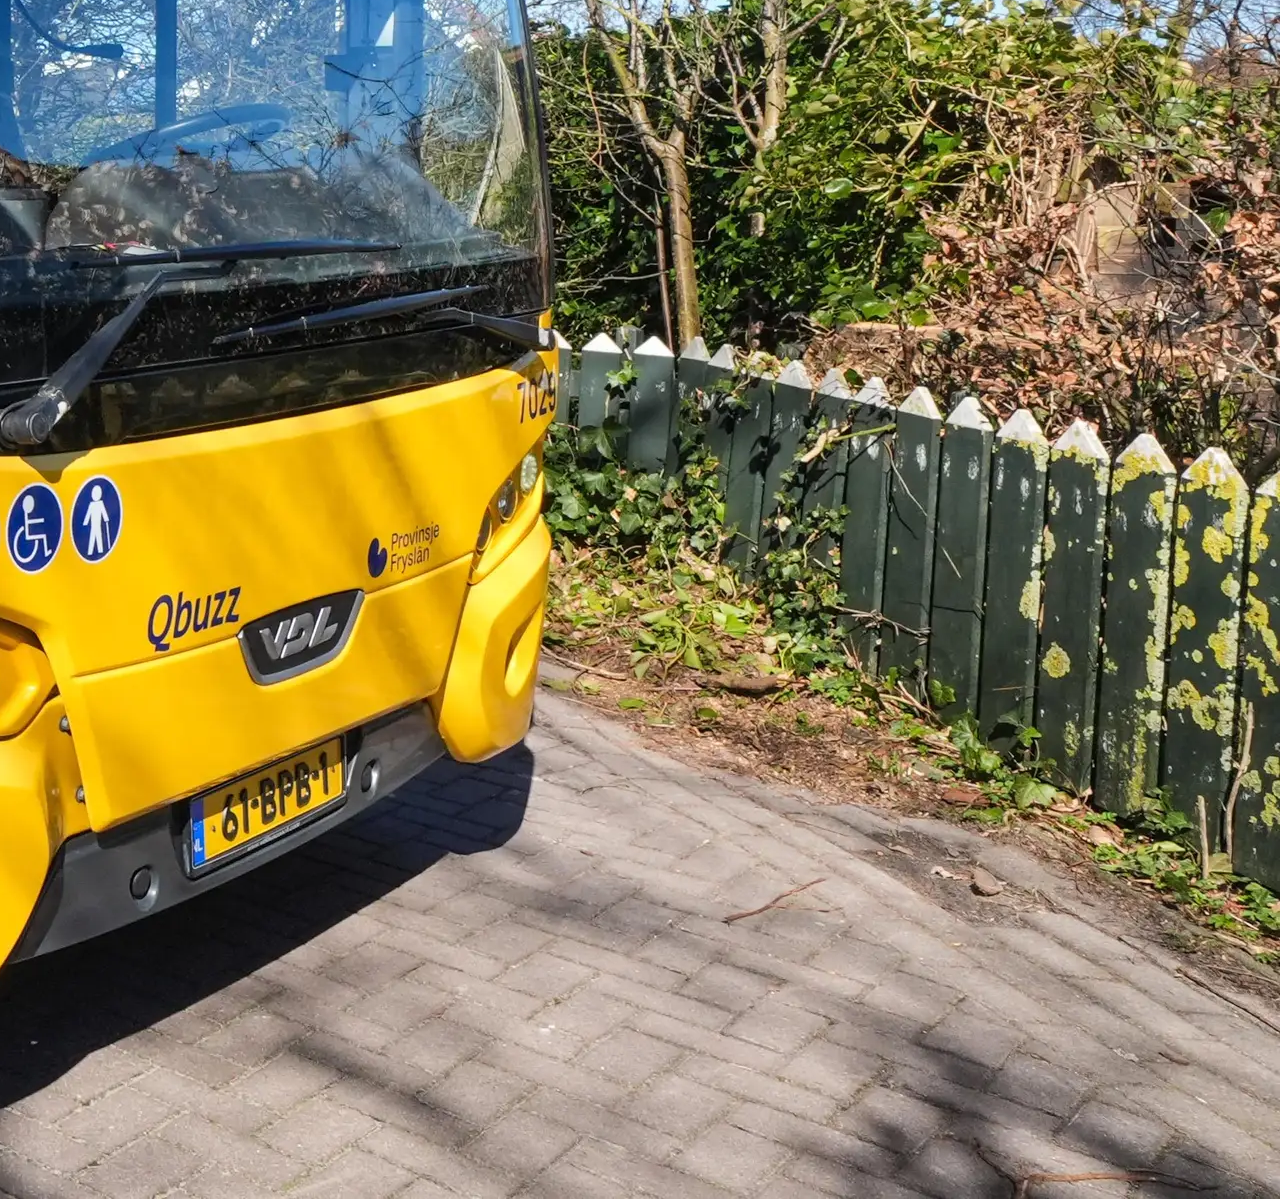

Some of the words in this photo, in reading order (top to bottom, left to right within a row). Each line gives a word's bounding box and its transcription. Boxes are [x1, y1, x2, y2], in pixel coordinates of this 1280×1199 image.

[517, 366, 556, 424] 7029
[390, 546, 430, 574] Fryslân
[391, 522, 440, 551] Provinsje
[147, 586, 242, 652] Qbuzz
[259, 606, 339, 660] VDL
[222, 752, 329, 842] 61-BPB-1
